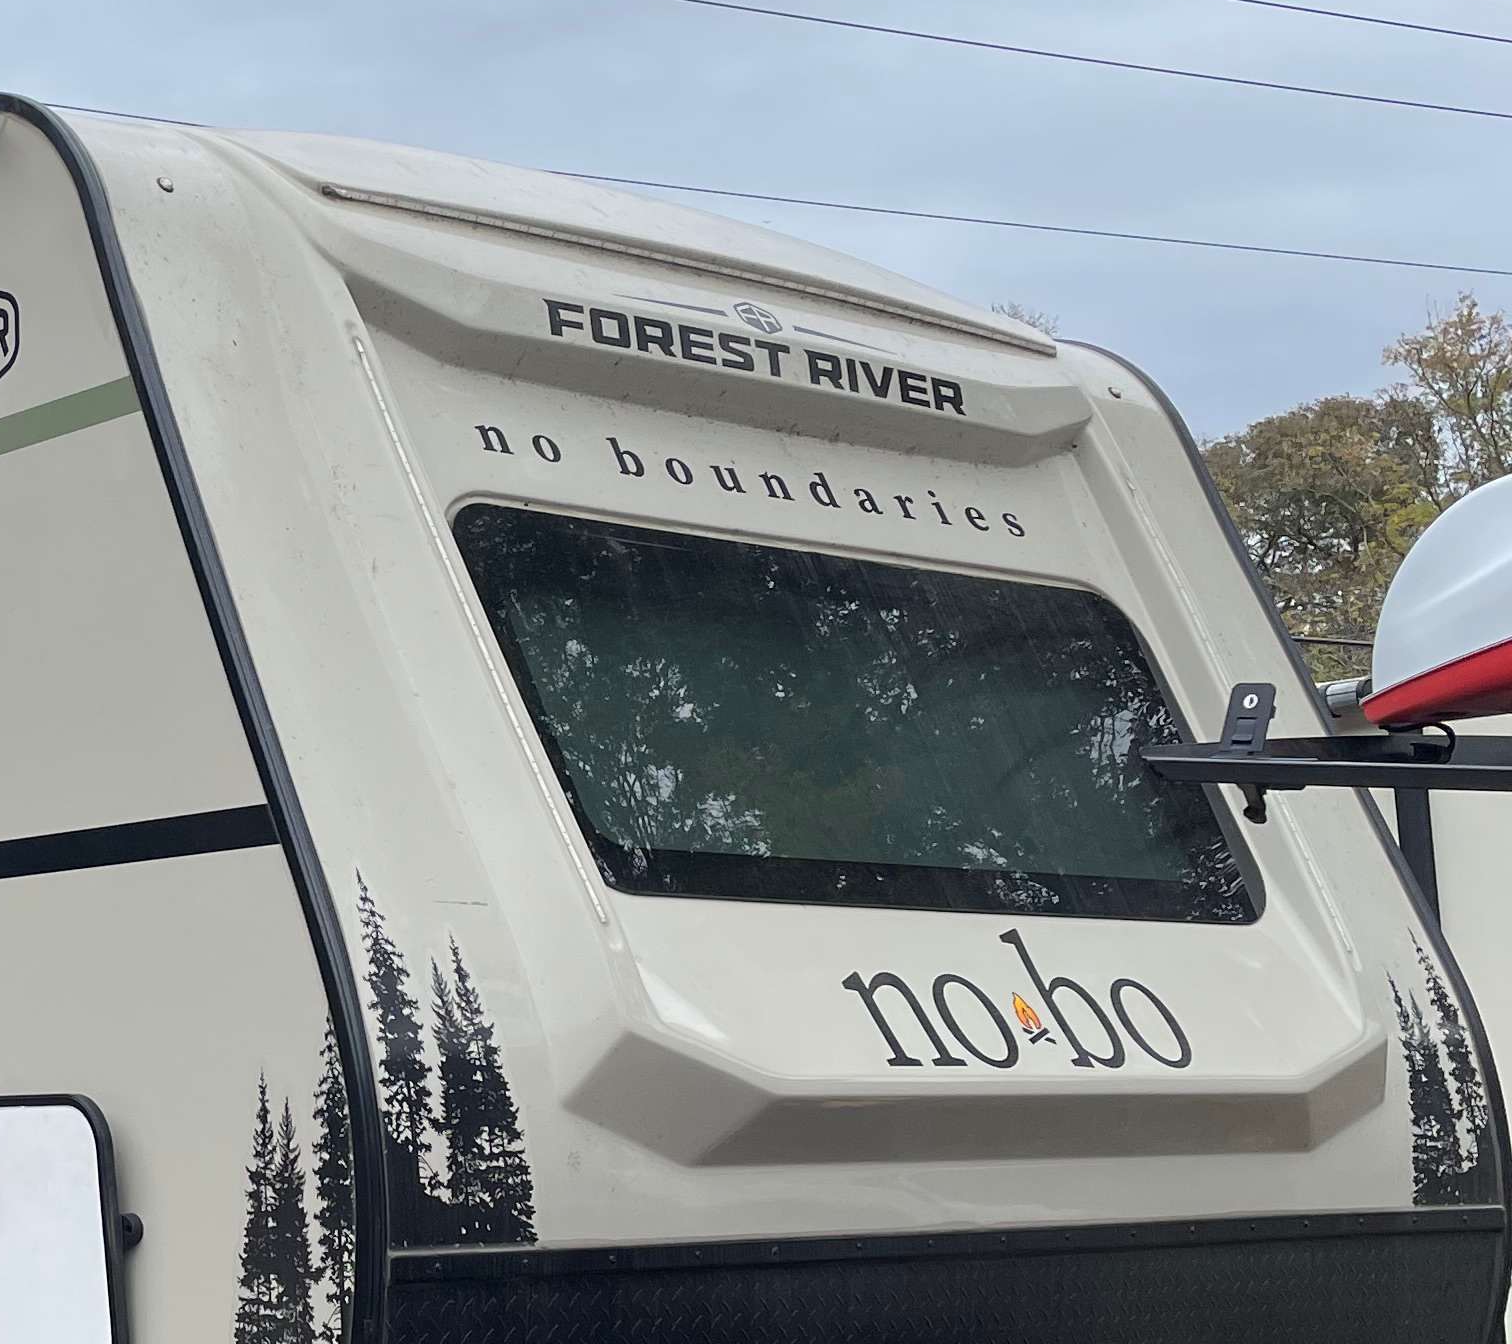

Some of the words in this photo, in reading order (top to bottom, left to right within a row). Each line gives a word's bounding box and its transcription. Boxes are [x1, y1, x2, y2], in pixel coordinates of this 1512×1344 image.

[542, 297, 790, 378] FOREST
[803, 348, 967, 416] RIVER
[473, 421, 563, 464] no
[606, 435, 1028, 539] boundaries
